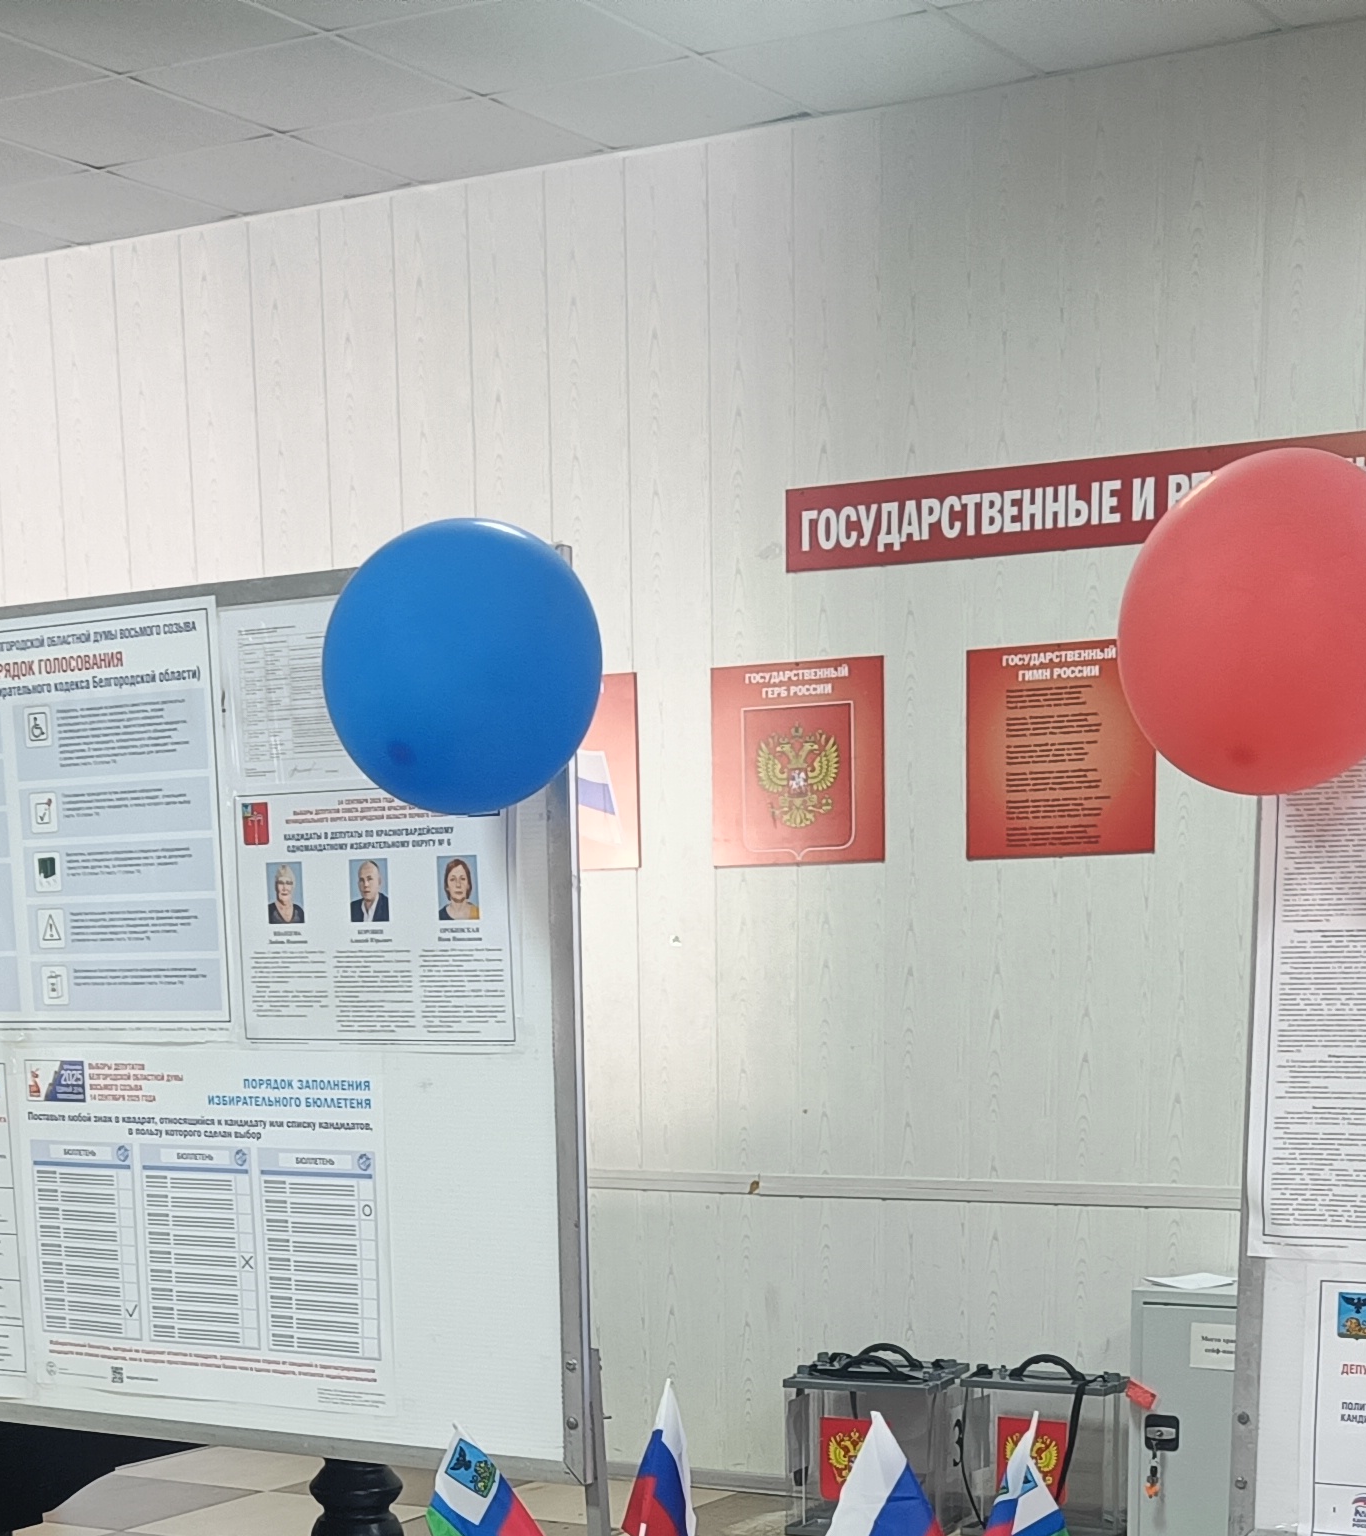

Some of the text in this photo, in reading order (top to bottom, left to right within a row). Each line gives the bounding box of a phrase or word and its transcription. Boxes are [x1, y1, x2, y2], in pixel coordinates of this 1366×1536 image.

[800, 479, 1122, 552] ГОСУДАРСТВЕННЫЕ
[1132, 476, 1155, 522] И
[46, 629, 91, 648] ОБЛАСТНОЙ
[92, 628, 118, 644] ДУМЫ
[119, 624, 161, 640] ВОСЬМОГО
[162, 620, 197, 635] СОЗЫВА
[37, 650, 123, 675] ГОЛОСОВАНИЯ
[1001, 645, 1117, 668] ГОСУДАРСТВЕННЫЙ
[53, 679, 90, 693] кодекса
[91, 669, 156, 689] Белгородской
[158, 665, 201, 683] области)
[745, 664, 849, 685] ГОСУДАРСТВЕННЫЙ
[1018, 664, 1099, 682] ГИМН РОССИИ
[761, 682, 832, 699] ГЕРБ РОССИИ
[60, 1070, 84, 1085] 2025
[243, 1078, 370, 1091] ПОРЯДОК ЗАПОЛНЕНИЯ
[207, 1094, 371, 1109] ИЗБИРАТЕЛЬНОГО БЮЛЛЕТЕНЯ
[27, 1111, 66, 1122] Поставьте
[67, 1112, 92, 1123] любой
[93, 1115, 113, 1123] знак
[122, 1116, 157, 1127] квадрат,
[159, 1115, 216, 1128] относящийся
[225, 1119, 267, 1130] кандидату
[268, 1120, 284, 1128] или
[285, 1120, 316, 1131] списку
[318, 1121, 373, 1132] кандидатов,
[135, 1127, 163, 1138] пользу
[164, 1128, 202, 1139] которого
[203, 1130, 232, 1138] сделан
[233, 1128, 262, 1141] выбор
